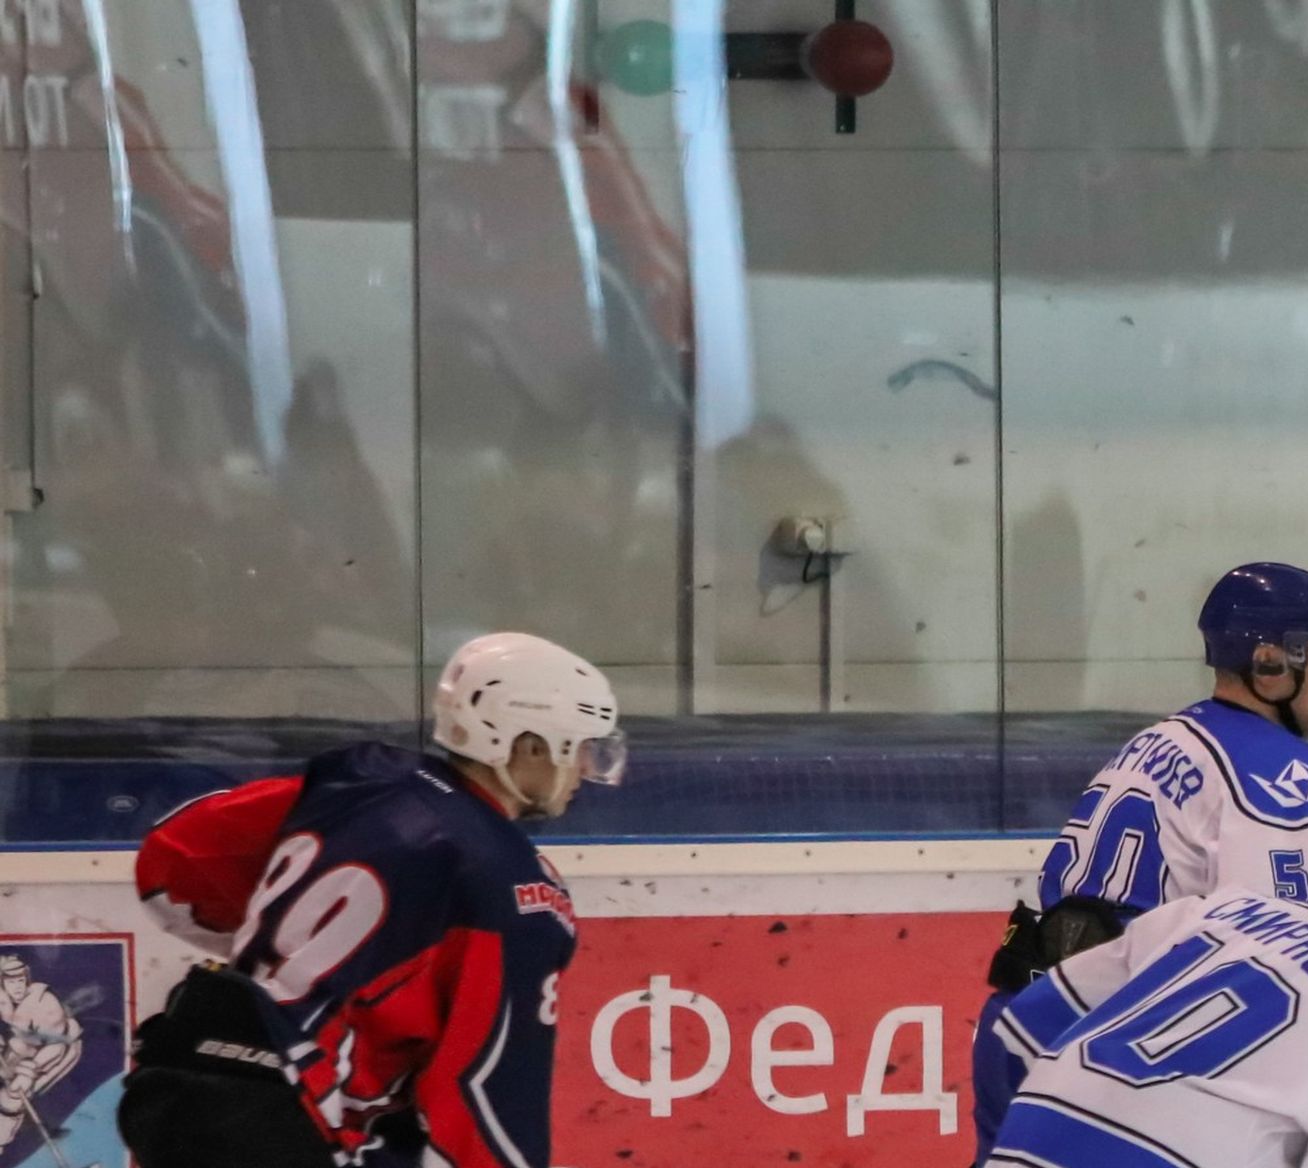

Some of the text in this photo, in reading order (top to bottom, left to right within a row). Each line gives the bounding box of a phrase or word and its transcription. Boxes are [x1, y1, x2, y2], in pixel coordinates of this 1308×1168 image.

[197, 1040, 283, 1068] BAUE
[590, 975, 958, 1137] Фед
[1040, 932, 1299, 1088] 10
